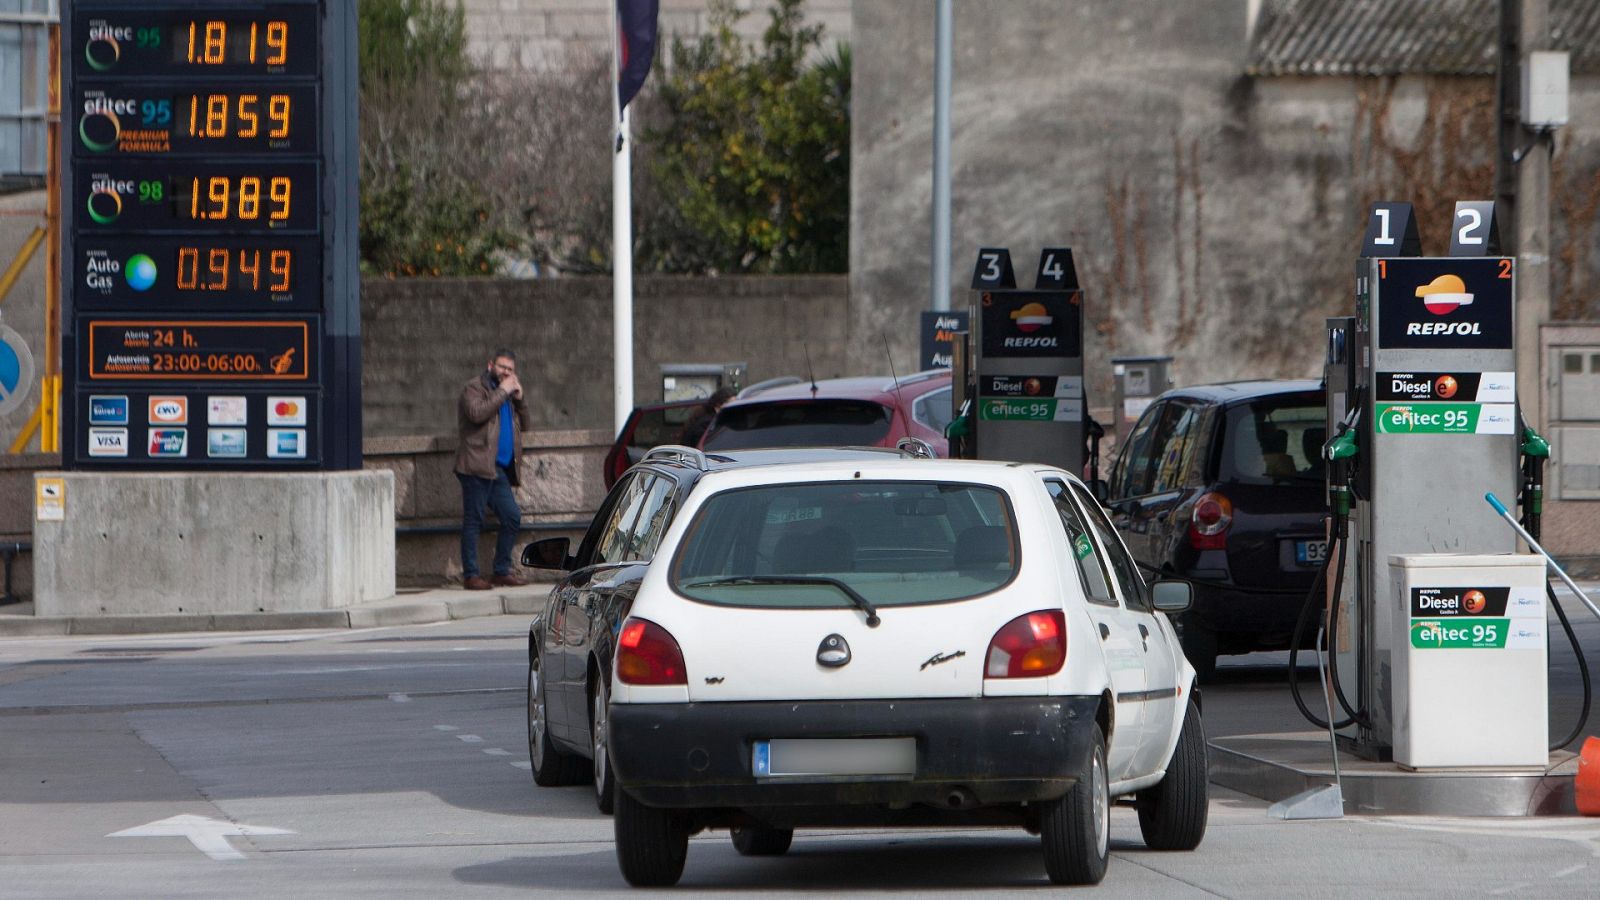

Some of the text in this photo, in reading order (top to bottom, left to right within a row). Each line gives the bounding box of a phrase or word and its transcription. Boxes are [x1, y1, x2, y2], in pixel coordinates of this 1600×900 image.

[90, 26, 160, 48] efitec 95
[187, 20, 288, 64] 1.819
[84, 98, 170, 124] efitec 95
[190, 94, 290, 138] 1.859
[120, 130, 168, 140] PREMIUM
[120, 141, 170, 152] FORMULA
[92, 178, 162, 202] efitec 98
[191, 176, 291, 220] 1.989
[1374, 209, 1394, 245] 1
[1457, 208, 1483, 245] 2
[86, 257, 120, 272] Auto
[177, 248, 292, 291] 0.949
[980, 254, 1000, 280] 3
[1042, 254, 1064, 280] 4
[1378, 260, 1386, 279] 1
[1498, 260, 1512, 278] 2
[86, 272, 112, 288] Gas
[982, 292, 992, 306] 3
[1070, 292, 1080, 305] 4
[934, 315, 960, 330] Aire
[1407, 322, 1482, 335] REPSOL
[153, 329, 198, 347] 24 h.
[935, 330, 953, 342] Air
[1004, 337, 1058, 348] REPSOL
[932, 352, 953, 369] Aug
[993, 381, 1022, 392] Diesel
[1392, 380, 1431, 392] Diesel
[992, 403, 1028, 416] efitec
[1030, 404, 1048, 416] 95
[1392, 412, 1440, 426] efitec
[1444, 411, 1468, 427] 95
[97, 436, 122, 446] VISA
[1420, 595, 1458, 608] Diesel
[1420, 626, 1469, 641] efitec
[1472, 625, 1497, 642] 95
